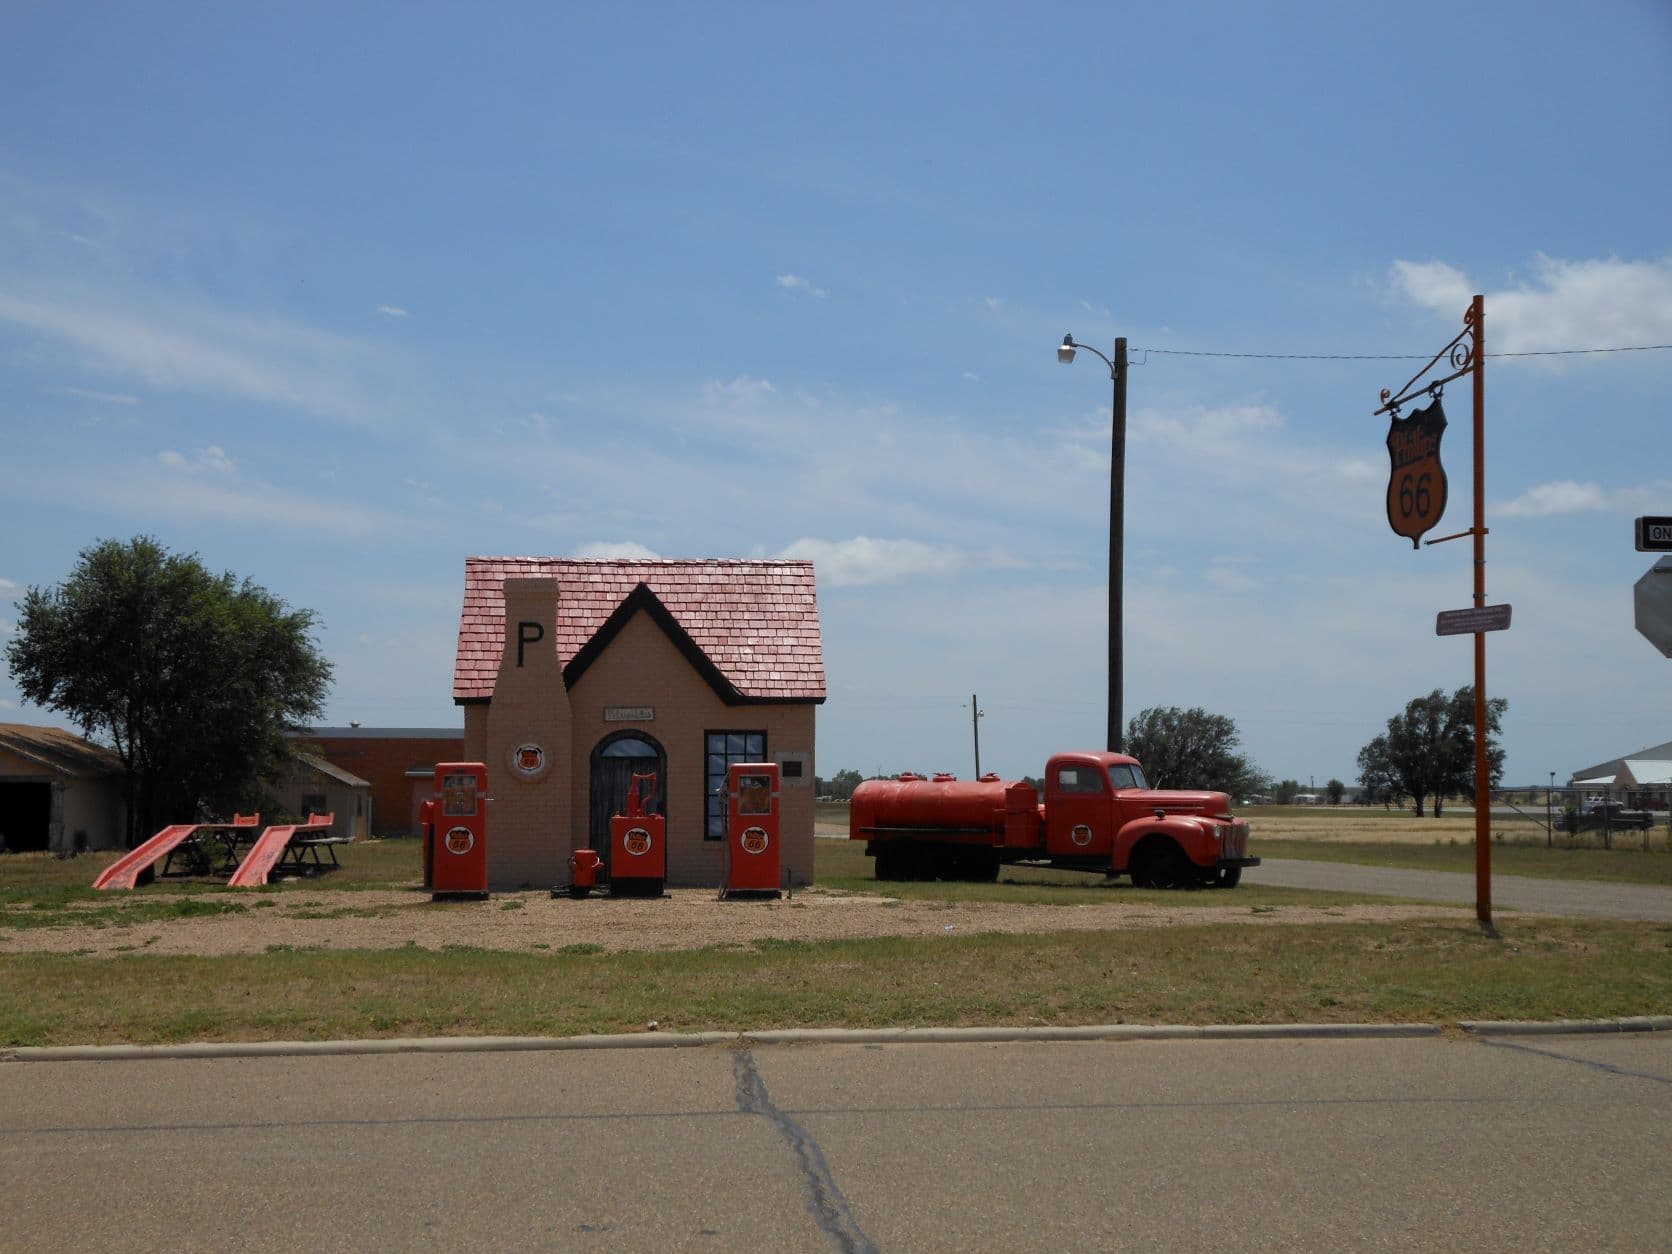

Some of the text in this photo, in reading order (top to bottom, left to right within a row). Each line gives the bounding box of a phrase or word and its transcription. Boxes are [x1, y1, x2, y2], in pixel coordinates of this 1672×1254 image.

[1400, 472, 1432, 518] 66
[516, 622, 544, 667] P
[453, 840, 466, 849] 66
[631, 841, 644, 850] 66
[749, 840, 761, 849] 66
